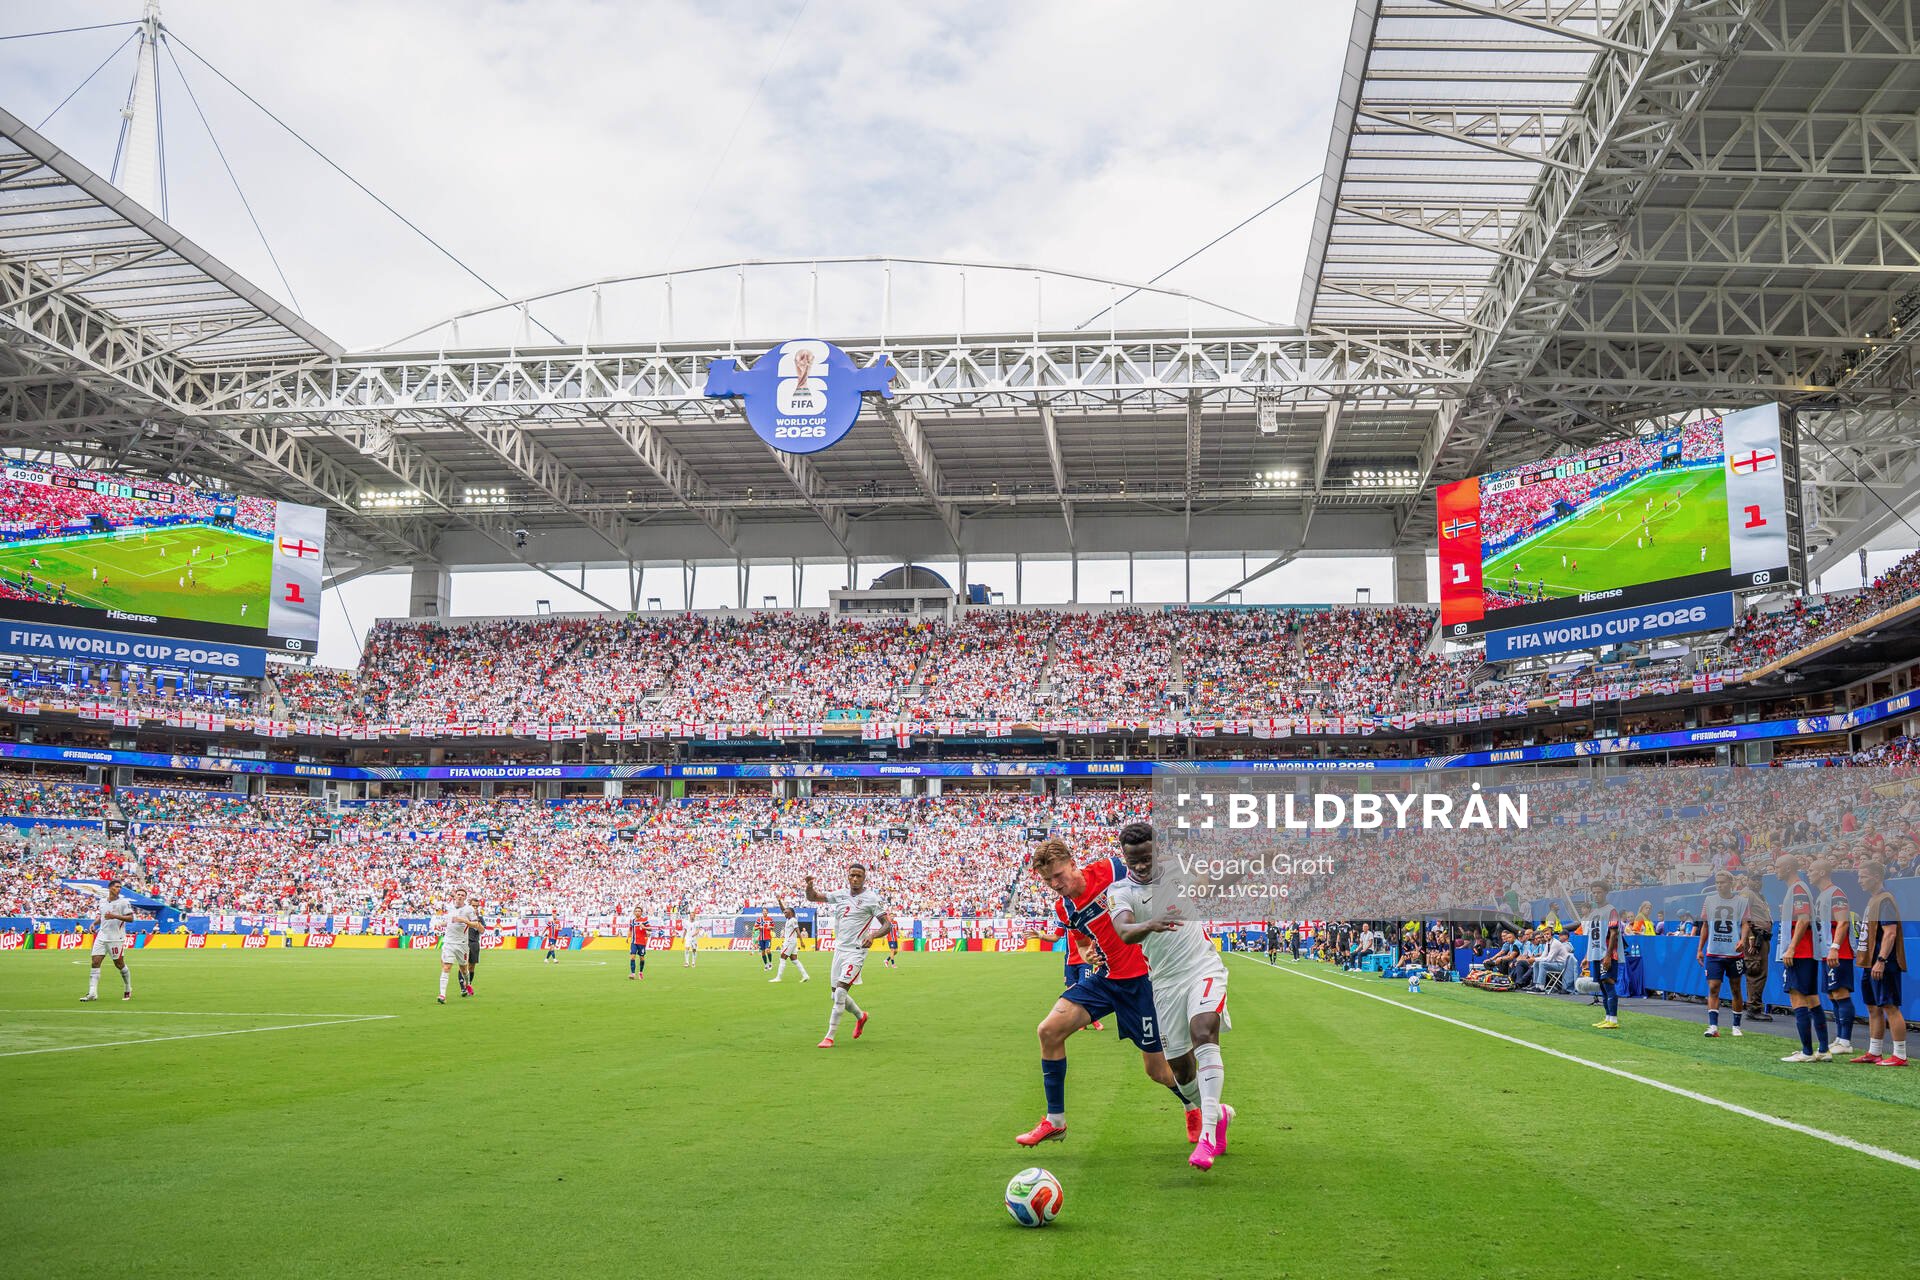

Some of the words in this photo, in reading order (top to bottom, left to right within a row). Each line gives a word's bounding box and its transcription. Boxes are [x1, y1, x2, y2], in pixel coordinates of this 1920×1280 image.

[791, 400, 814, 408] FIFA
[776, 418, 807, 426] WORLD
[809, 417, 827, 425] CUP
[775, 426, 826, 438] 2026
[12, 470, 44, 483] 49:09
[1491, 479, 1515, 493] 49:09
[1744, 504, 1767, 529] 1
[1452, 562, 1470, 584] 1
[1754, 573, 1768, 584] CC
[285, 582, 305, 604] 1
[1578, 588, 1623, 603] Hisense
[106, 609, 158, 624] Hisense
[1455, 624, 1467, 634] CC
[1507, 632, 1541, 651] FIFA
[1543, 623, 1602, 645] WORLD
[1605, 617, 1640, 635] CUP
[1643, 606, 1706, 630] 2026
[10, 631, 55, 649] FIFA
[58, 635, 130, 656] WORLD
[132, 644, 172, 660] CUP
[174, 648, 240, 667] 2026
[287, 640, 300, 649] CC
[1887, 695, 1910, 713] MIAMI
[1691, 730, 1737, 742] #FIFAWorldCup
[63, 750, 112, 762] #FIFAWorldCup
[1490, 750, 1523, 762] MIAMI
[295, 765, 332, 776] MIAMI
[449, 768, 470, 777] FIFA
[472, 768, 506, 777] WORLD
[507, 768, 527, 777] CUP
[527, 767, 561, 776] 2026
[682, 767, 717, 776] MIAMI
[880, 766, 921, 775] #FIFAWorldCup
[1088, 763, 1124, 773] MIAMI
[1253, 762, 1276, 772] FIFA
[1277, 762, 1315, 771] WORLD
[1316, 762, 1337, 771] CUP
[1338, 761, 1375, 770] 2026
[843, 906, 850, 918] 2
[408, 923, 427, 932] FIFA
[60, 933, 82, 950] Lay's
[187, 934, 205, 948] Lay's
[243, 934, 267, 948] Lay's
[308, 934, 333, 948] Lay's
[413, 935, 436, 949] Lay's
[646, 936, 671, 950] Lay's
[929, 937, 954, 951] Lay's
[999, 937, 1024, 951] Lay's
[111, 947, 119, 955] 10
[845, 964, 854, 977] 2
[1202, 977, 1214, 998] 7
[1141, 1016, 1154, 1038] 5
